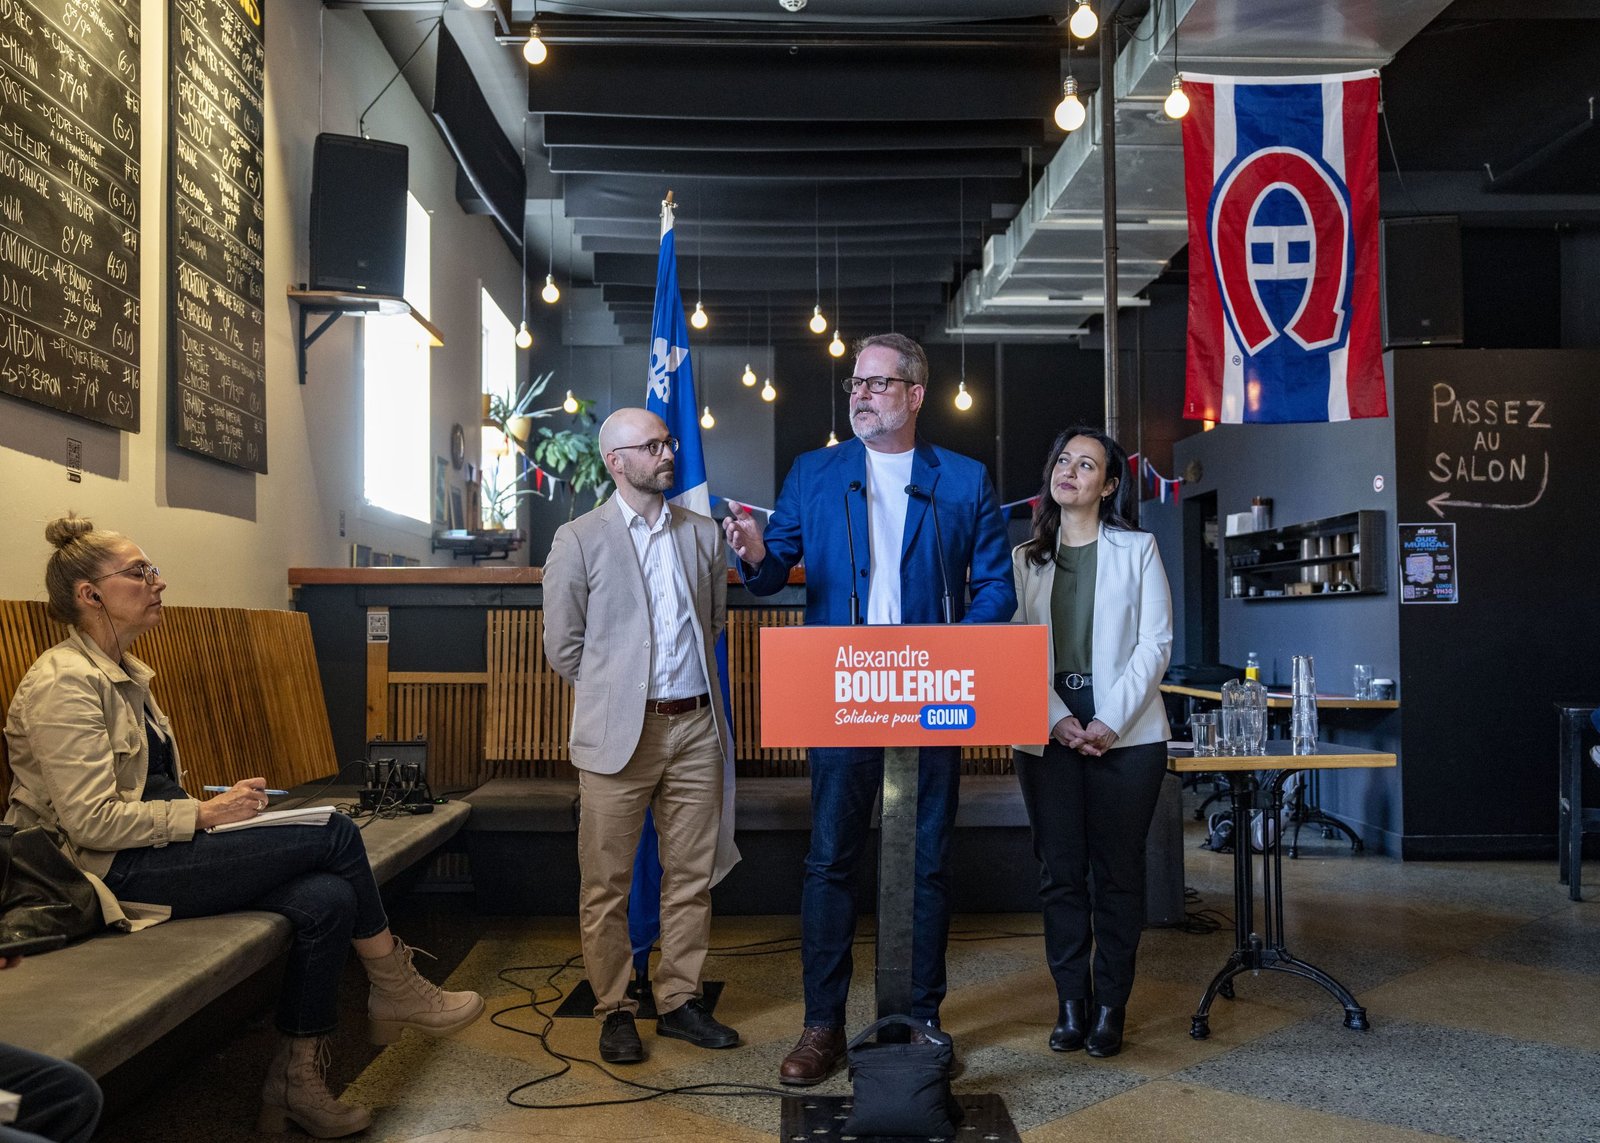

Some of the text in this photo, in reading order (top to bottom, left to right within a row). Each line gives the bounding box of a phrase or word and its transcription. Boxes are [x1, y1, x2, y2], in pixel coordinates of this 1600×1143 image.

[1432, 382, 1552, 428] PASSEZ
[1474, 431, 1500, 452] AU
[1428, 452, 1527, 483] SALON
[835, 645, 930, 669] Alexandre
[834, 669, 976, 703] BOULERICE
[834, 708, 968, 729] Solidaire pour GOUIN
